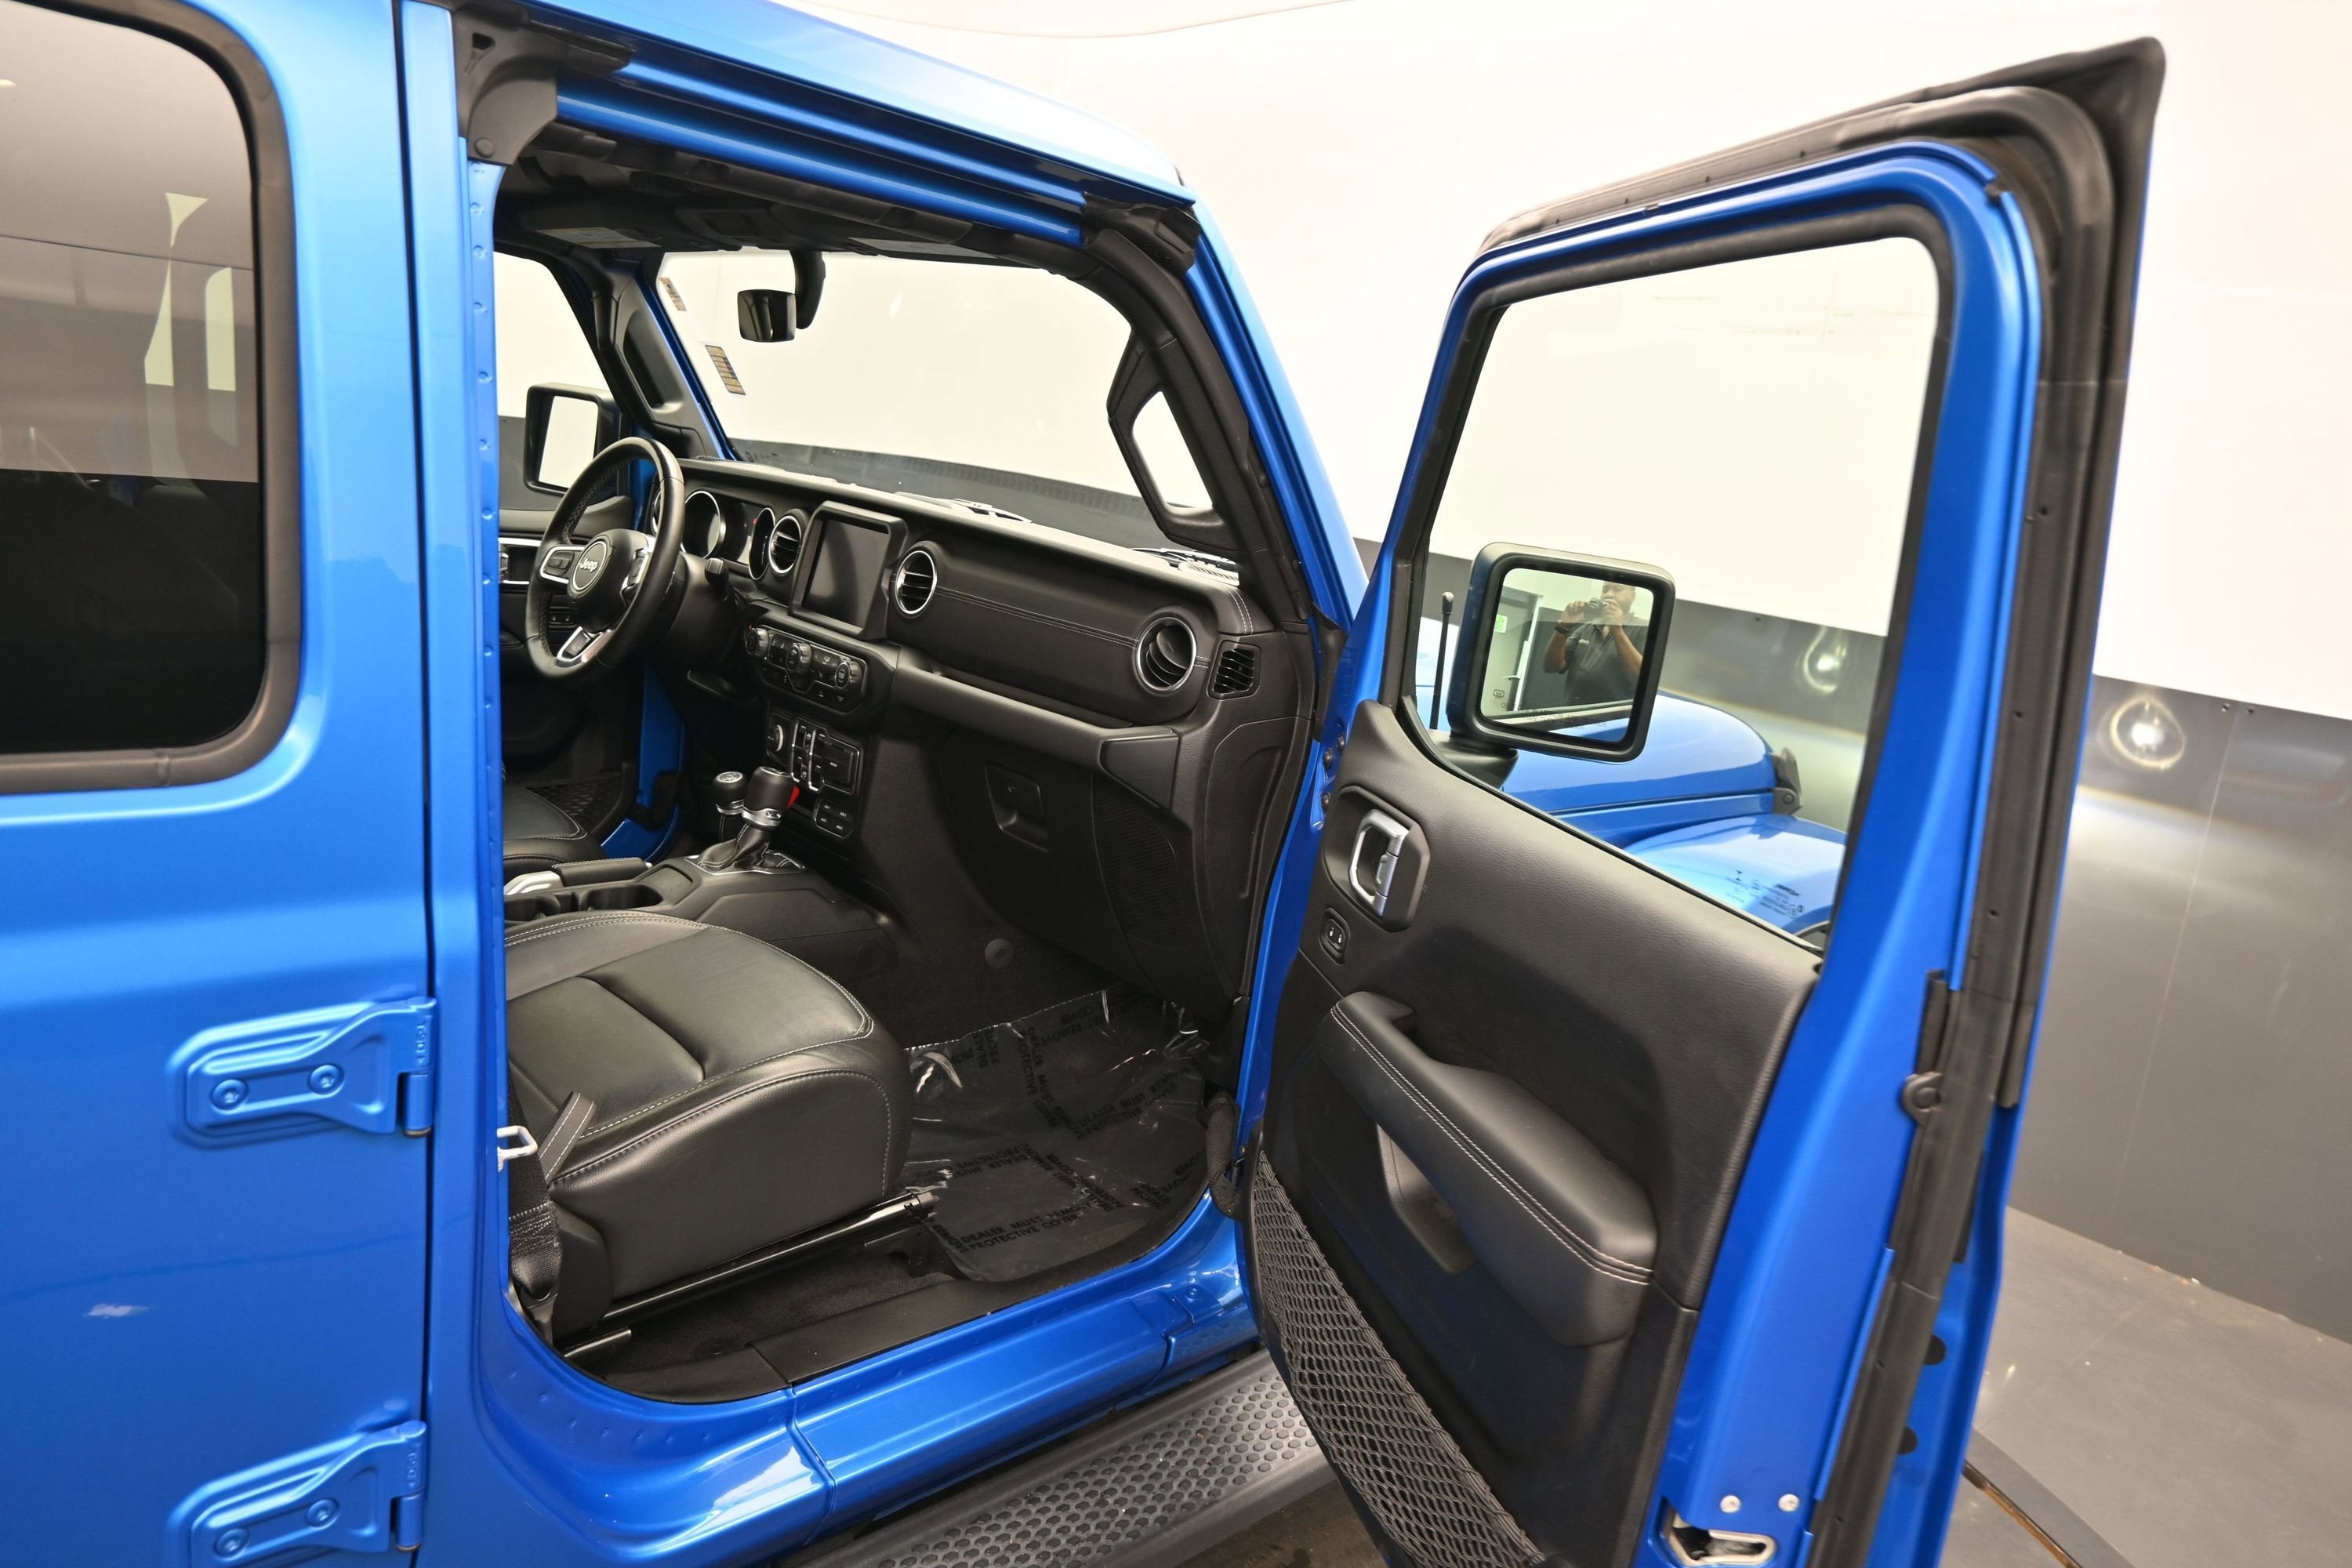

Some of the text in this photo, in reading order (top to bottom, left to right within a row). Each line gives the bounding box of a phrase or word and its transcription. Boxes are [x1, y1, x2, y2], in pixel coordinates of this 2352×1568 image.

[580, 557, 598, 572] Jeep
[1027, 1027, 1044, 1067] DEALER
[1036, 1075, 1055, 1103] MUST
[1120, 1093, 1146, 1108] MUST
[960, 1226, 1006, 1243] DEALER
[1010, 1216, 1044, 1229] MUST
[969, 1225, 1040, 1250] PROTECTIVE
